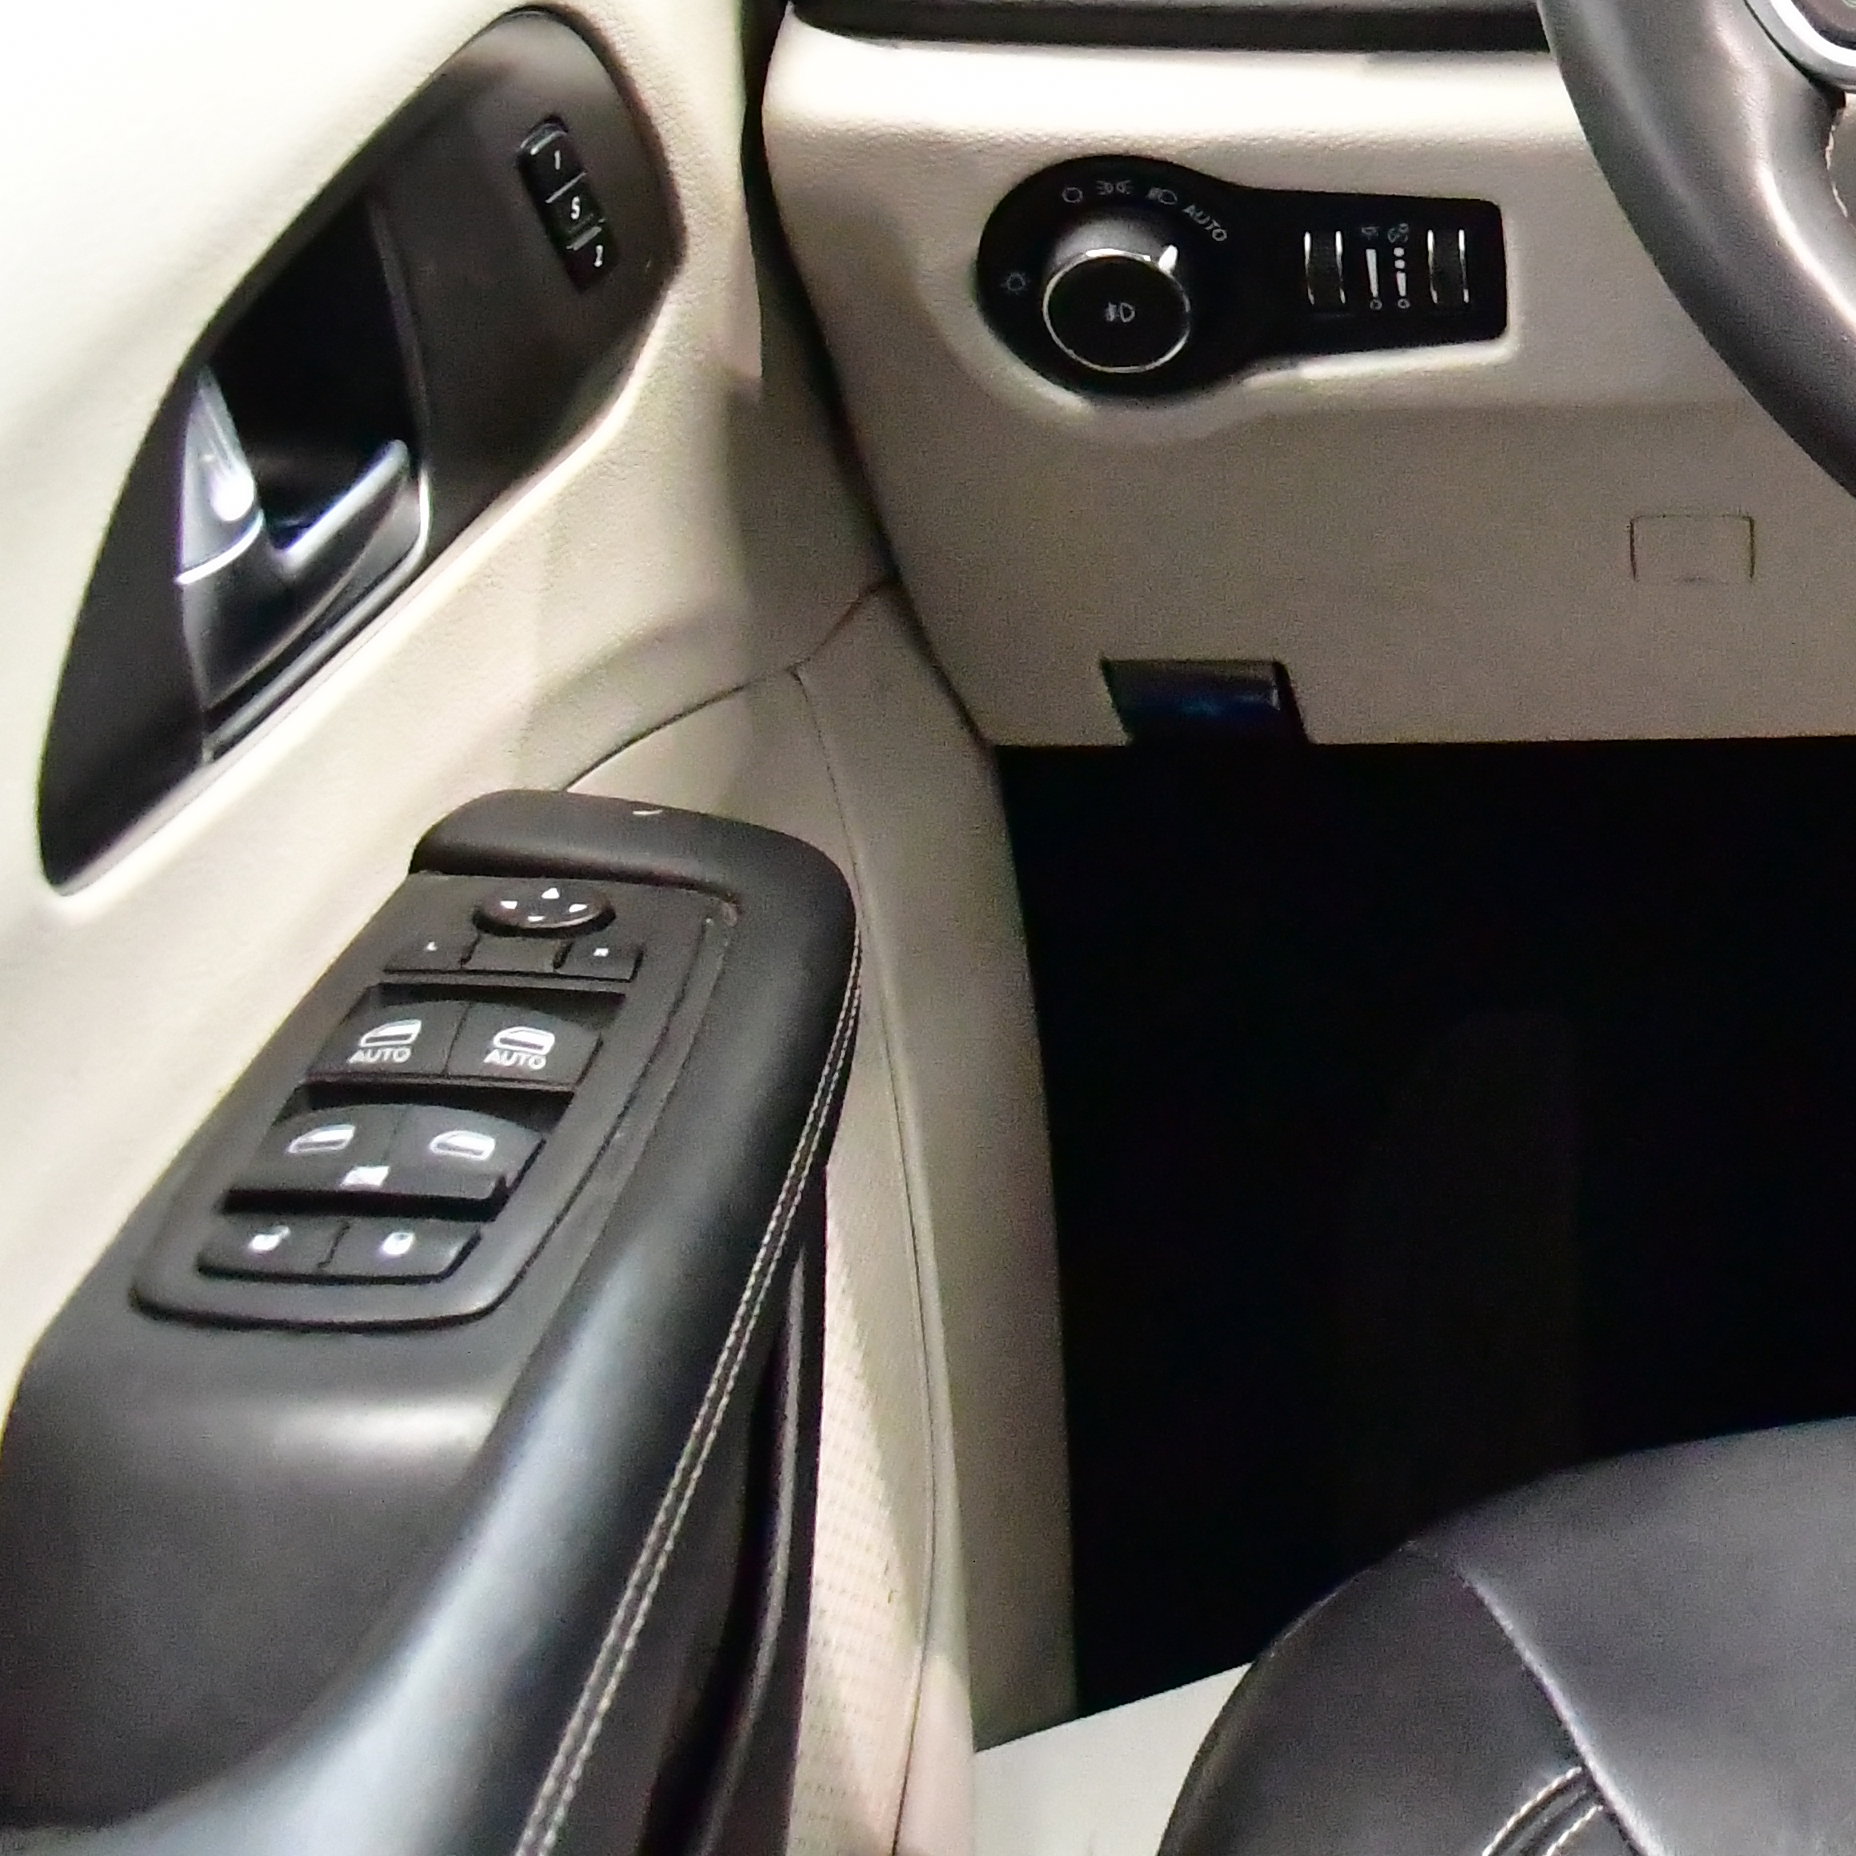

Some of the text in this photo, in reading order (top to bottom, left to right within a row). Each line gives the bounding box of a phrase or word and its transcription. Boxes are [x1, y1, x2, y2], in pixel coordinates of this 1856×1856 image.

[1182, 203, 1229, 242] AUTO
[348, 1045, 412, 1065] AUTO
[484, 1049, 547, 1071] AUTO
